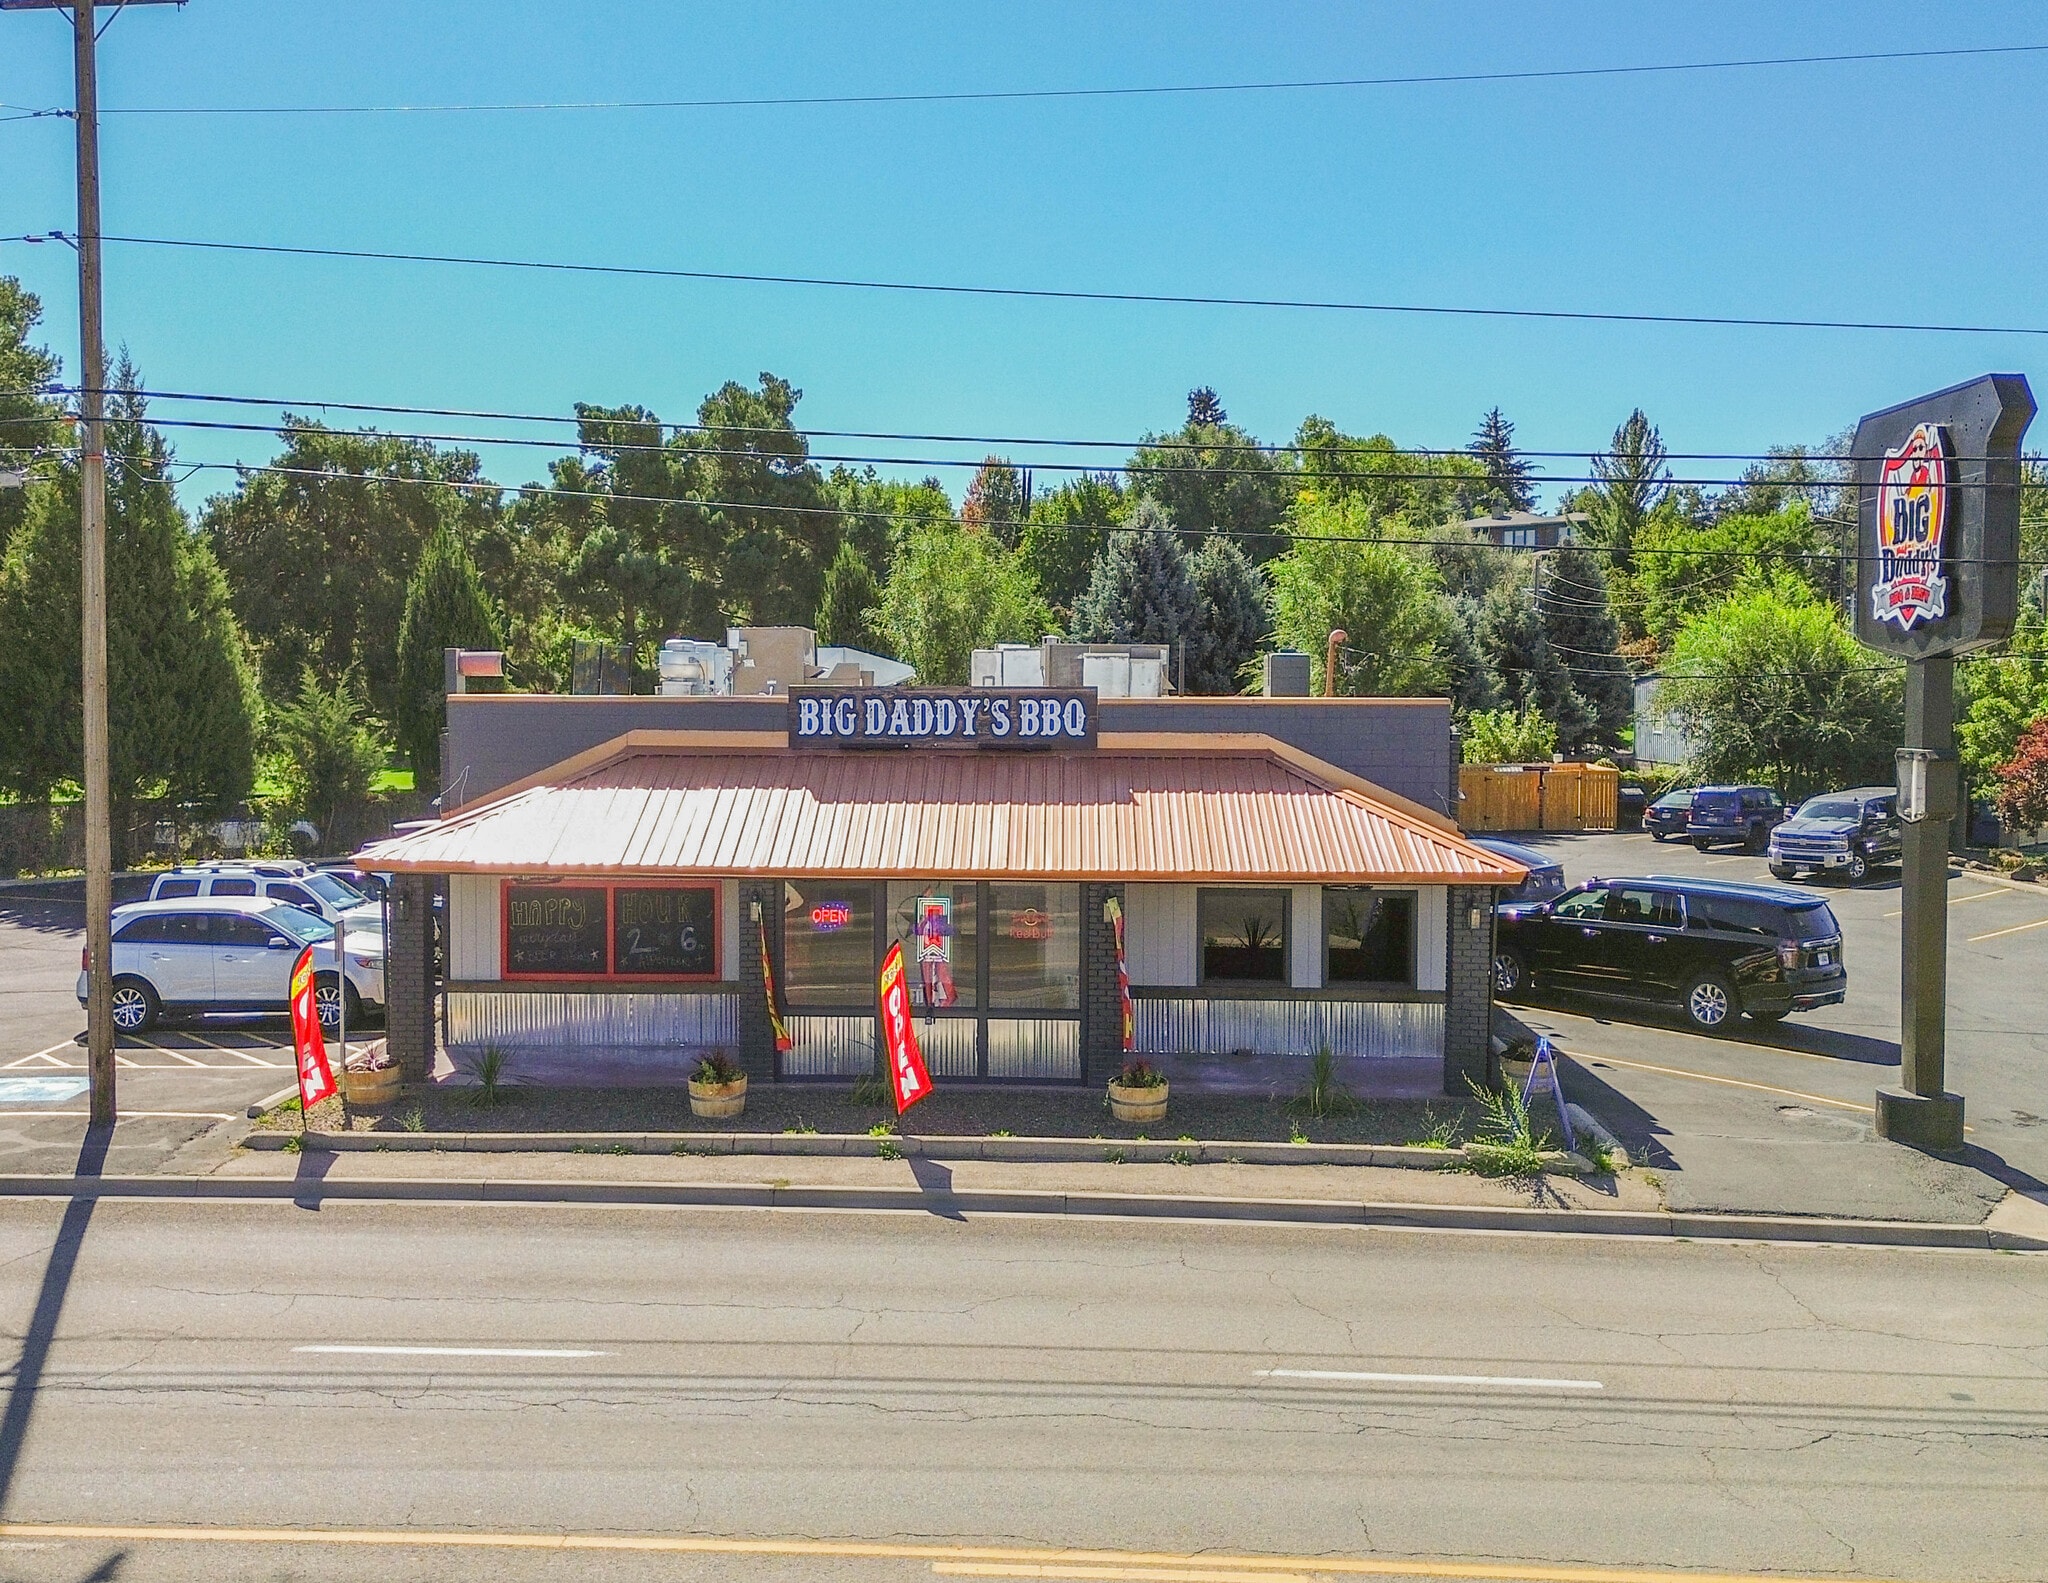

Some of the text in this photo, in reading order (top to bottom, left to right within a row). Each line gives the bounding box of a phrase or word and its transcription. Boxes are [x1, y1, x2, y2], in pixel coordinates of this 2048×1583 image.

[1893, 494, 1930, 545] BIG
[799, 698, 1087, 737] BIG DADDY'S BBQ
[510, 897, 587, 930] HAPPY
[812, 909, 849, 924] OPEN
[681, 926, 698, 952] 6
[888, 984, 920, 1101] OPEN
